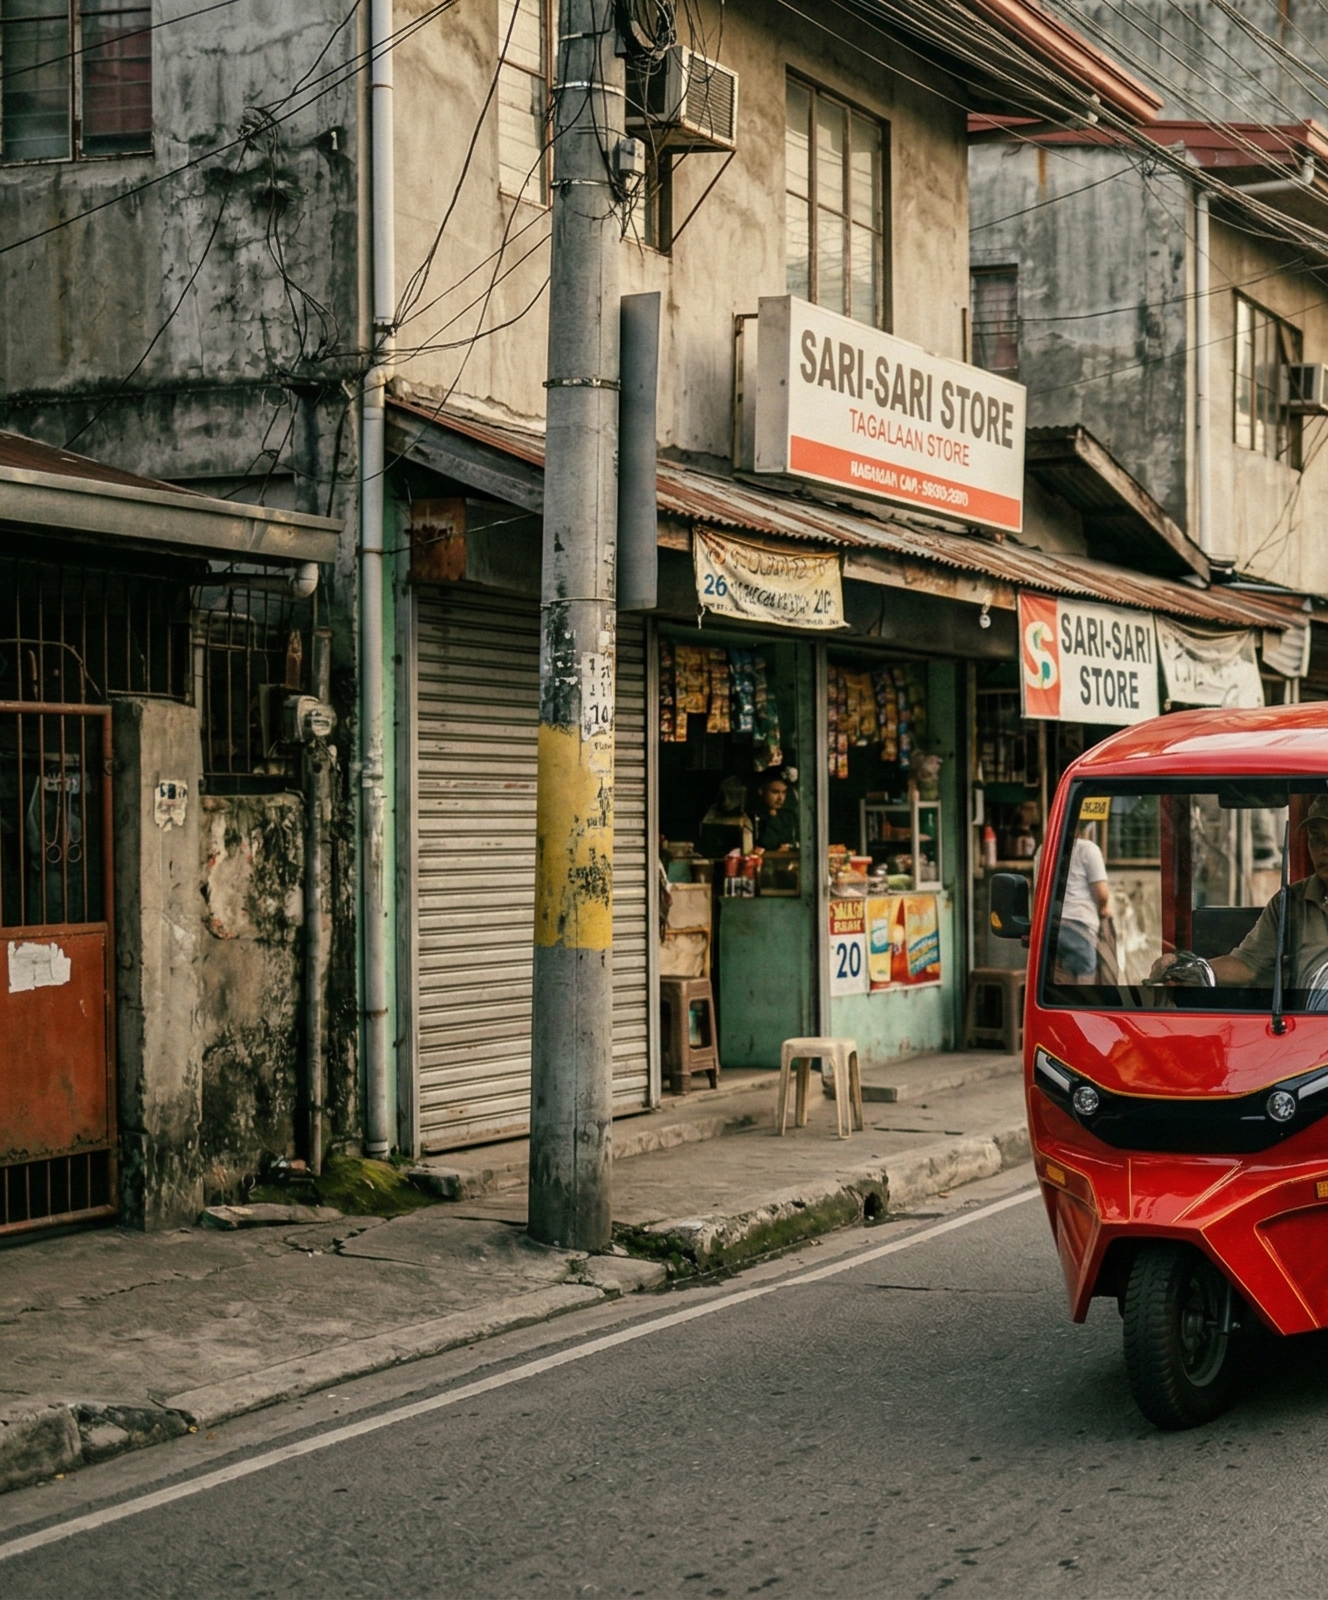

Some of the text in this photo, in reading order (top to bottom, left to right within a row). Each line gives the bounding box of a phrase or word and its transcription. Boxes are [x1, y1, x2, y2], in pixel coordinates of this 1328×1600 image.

[800, 329, 1014, 449] SARI-SARI STORE
[849, 408, 970, 467] TAGALAAN STORE
[704, 573, 728, 597] 26
[1061, 612, 1153, 664] SARI-SARI
[1080, 665, 1140, 709] STORE
[836, 941, 861, 979] 20
